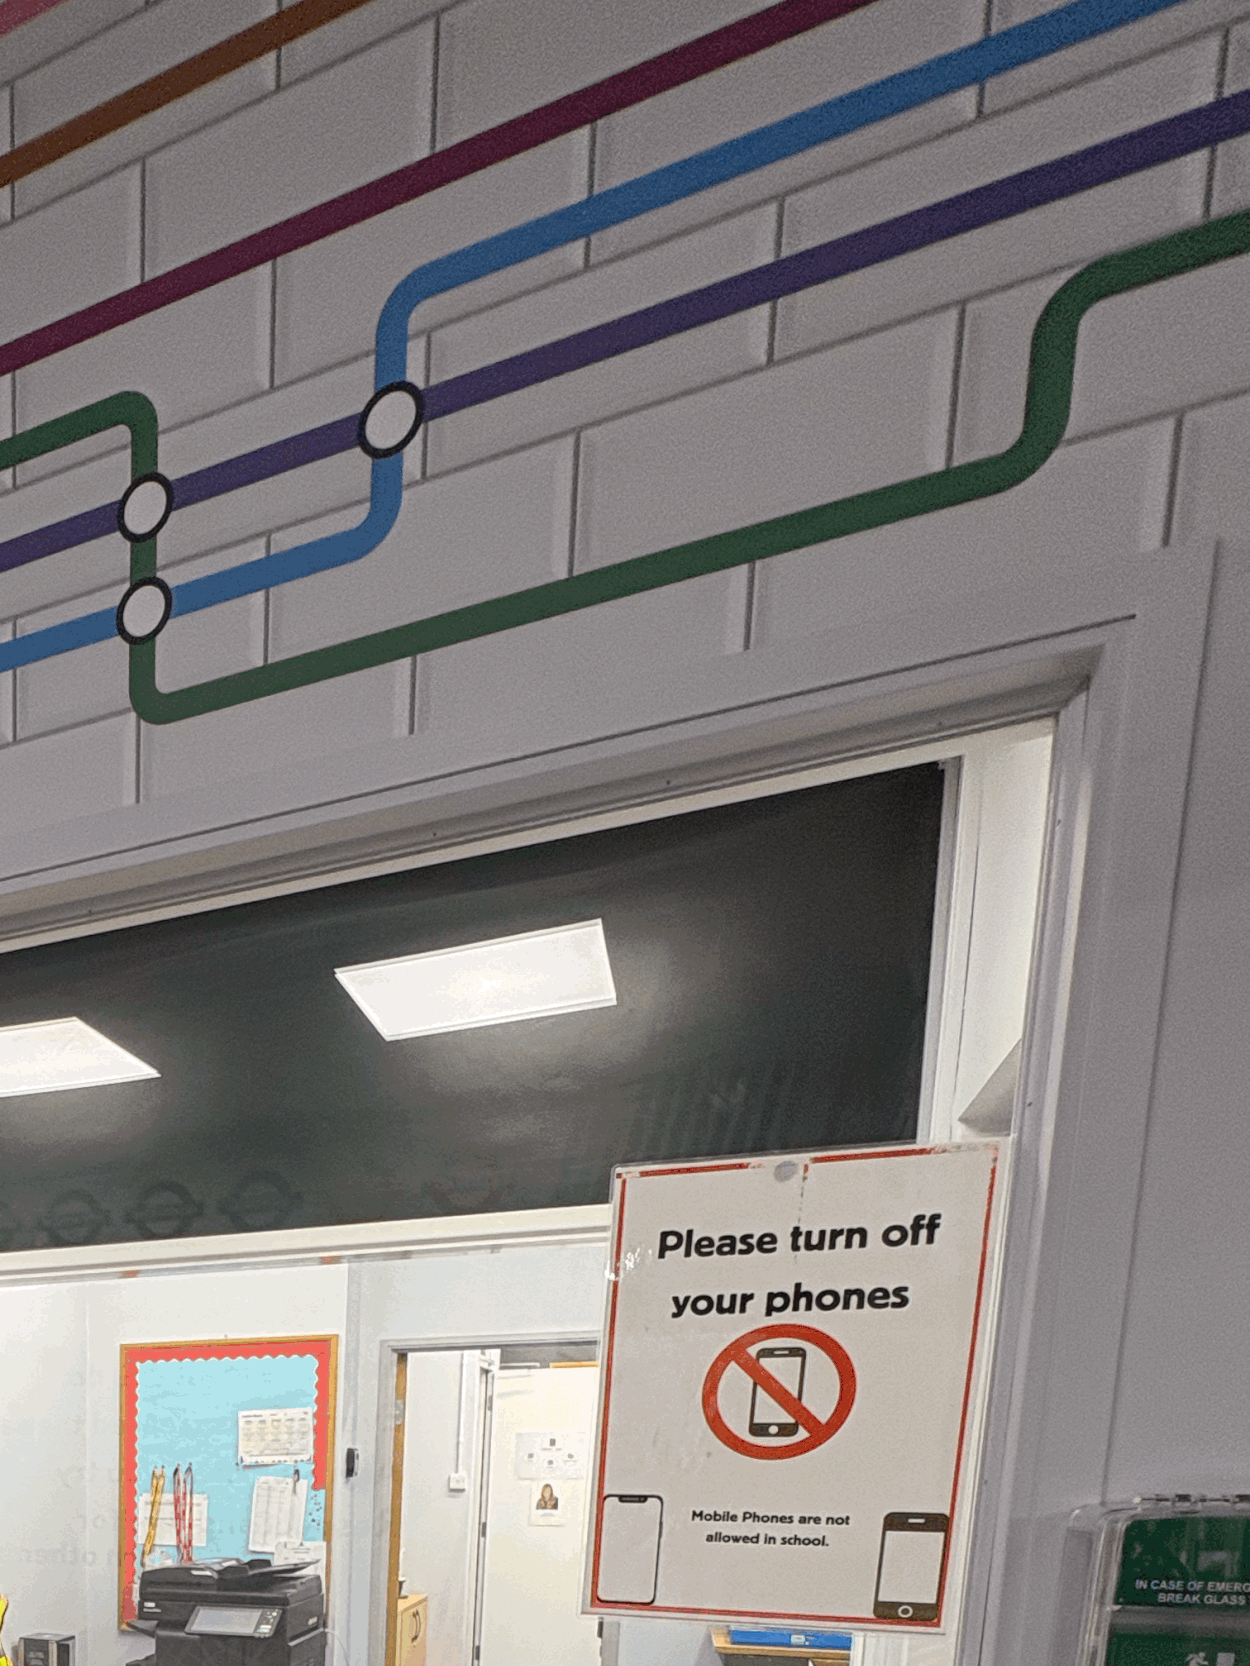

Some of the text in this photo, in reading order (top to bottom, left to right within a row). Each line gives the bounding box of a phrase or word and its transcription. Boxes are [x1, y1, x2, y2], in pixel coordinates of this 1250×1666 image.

[657, 1213, 941, 1259] Please turn off
[671, 1282, 909, 1319] your phones
[691, 1510, 850, 1526] Mobile Phones are not
[706, 1531, 829, 1547] allowed in school.
[1135, 1580, 1148, 1590] IN
[1151, 1580, 1185, 1590] CASE
[1187, 1581, 1205, 1591] OF
[1158, 1593, 1246, 1605] BREAK GLASS
